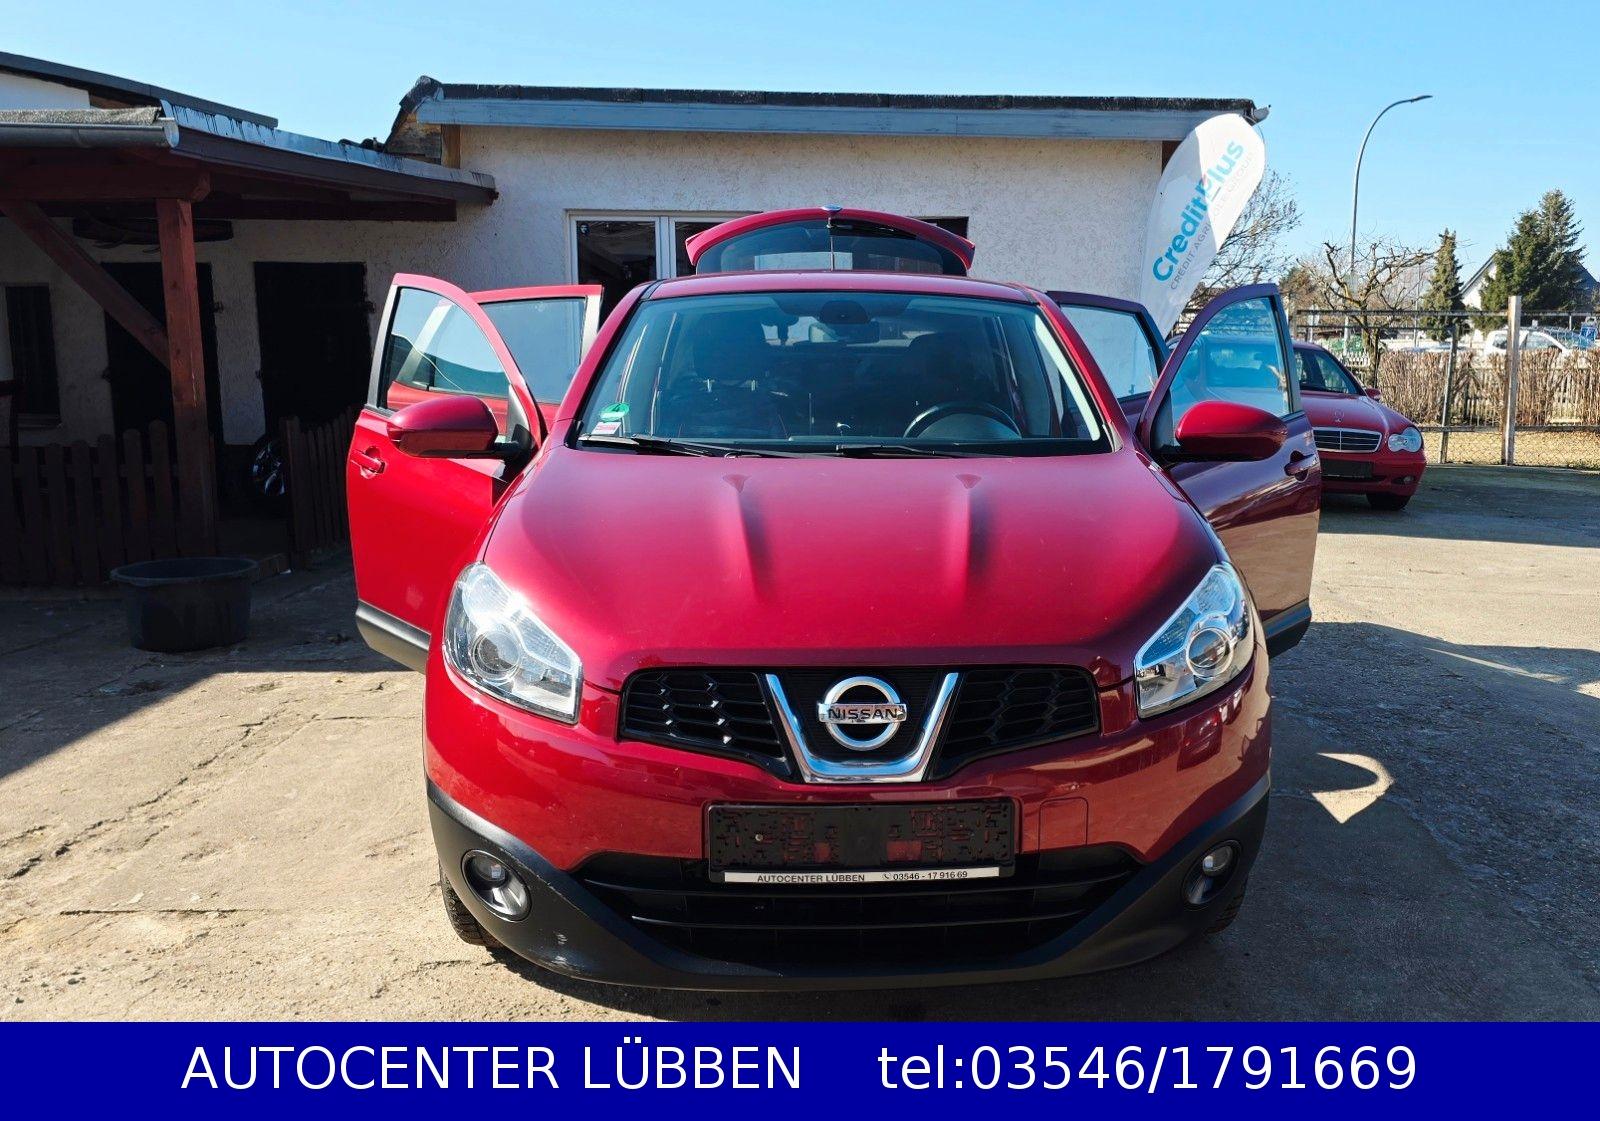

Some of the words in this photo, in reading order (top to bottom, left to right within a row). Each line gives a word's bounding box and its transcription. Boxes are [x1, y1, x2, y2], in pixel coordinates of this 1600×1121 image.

[1152, 141, 1245, 282] CreditPlus
[827, 708, 898, 720] NISSAN
[757, 874, 823, 883] AUTOCENTER
[826, 872, 865, 883] LÜBBEN
[892, 872, 920, 881] 03546
